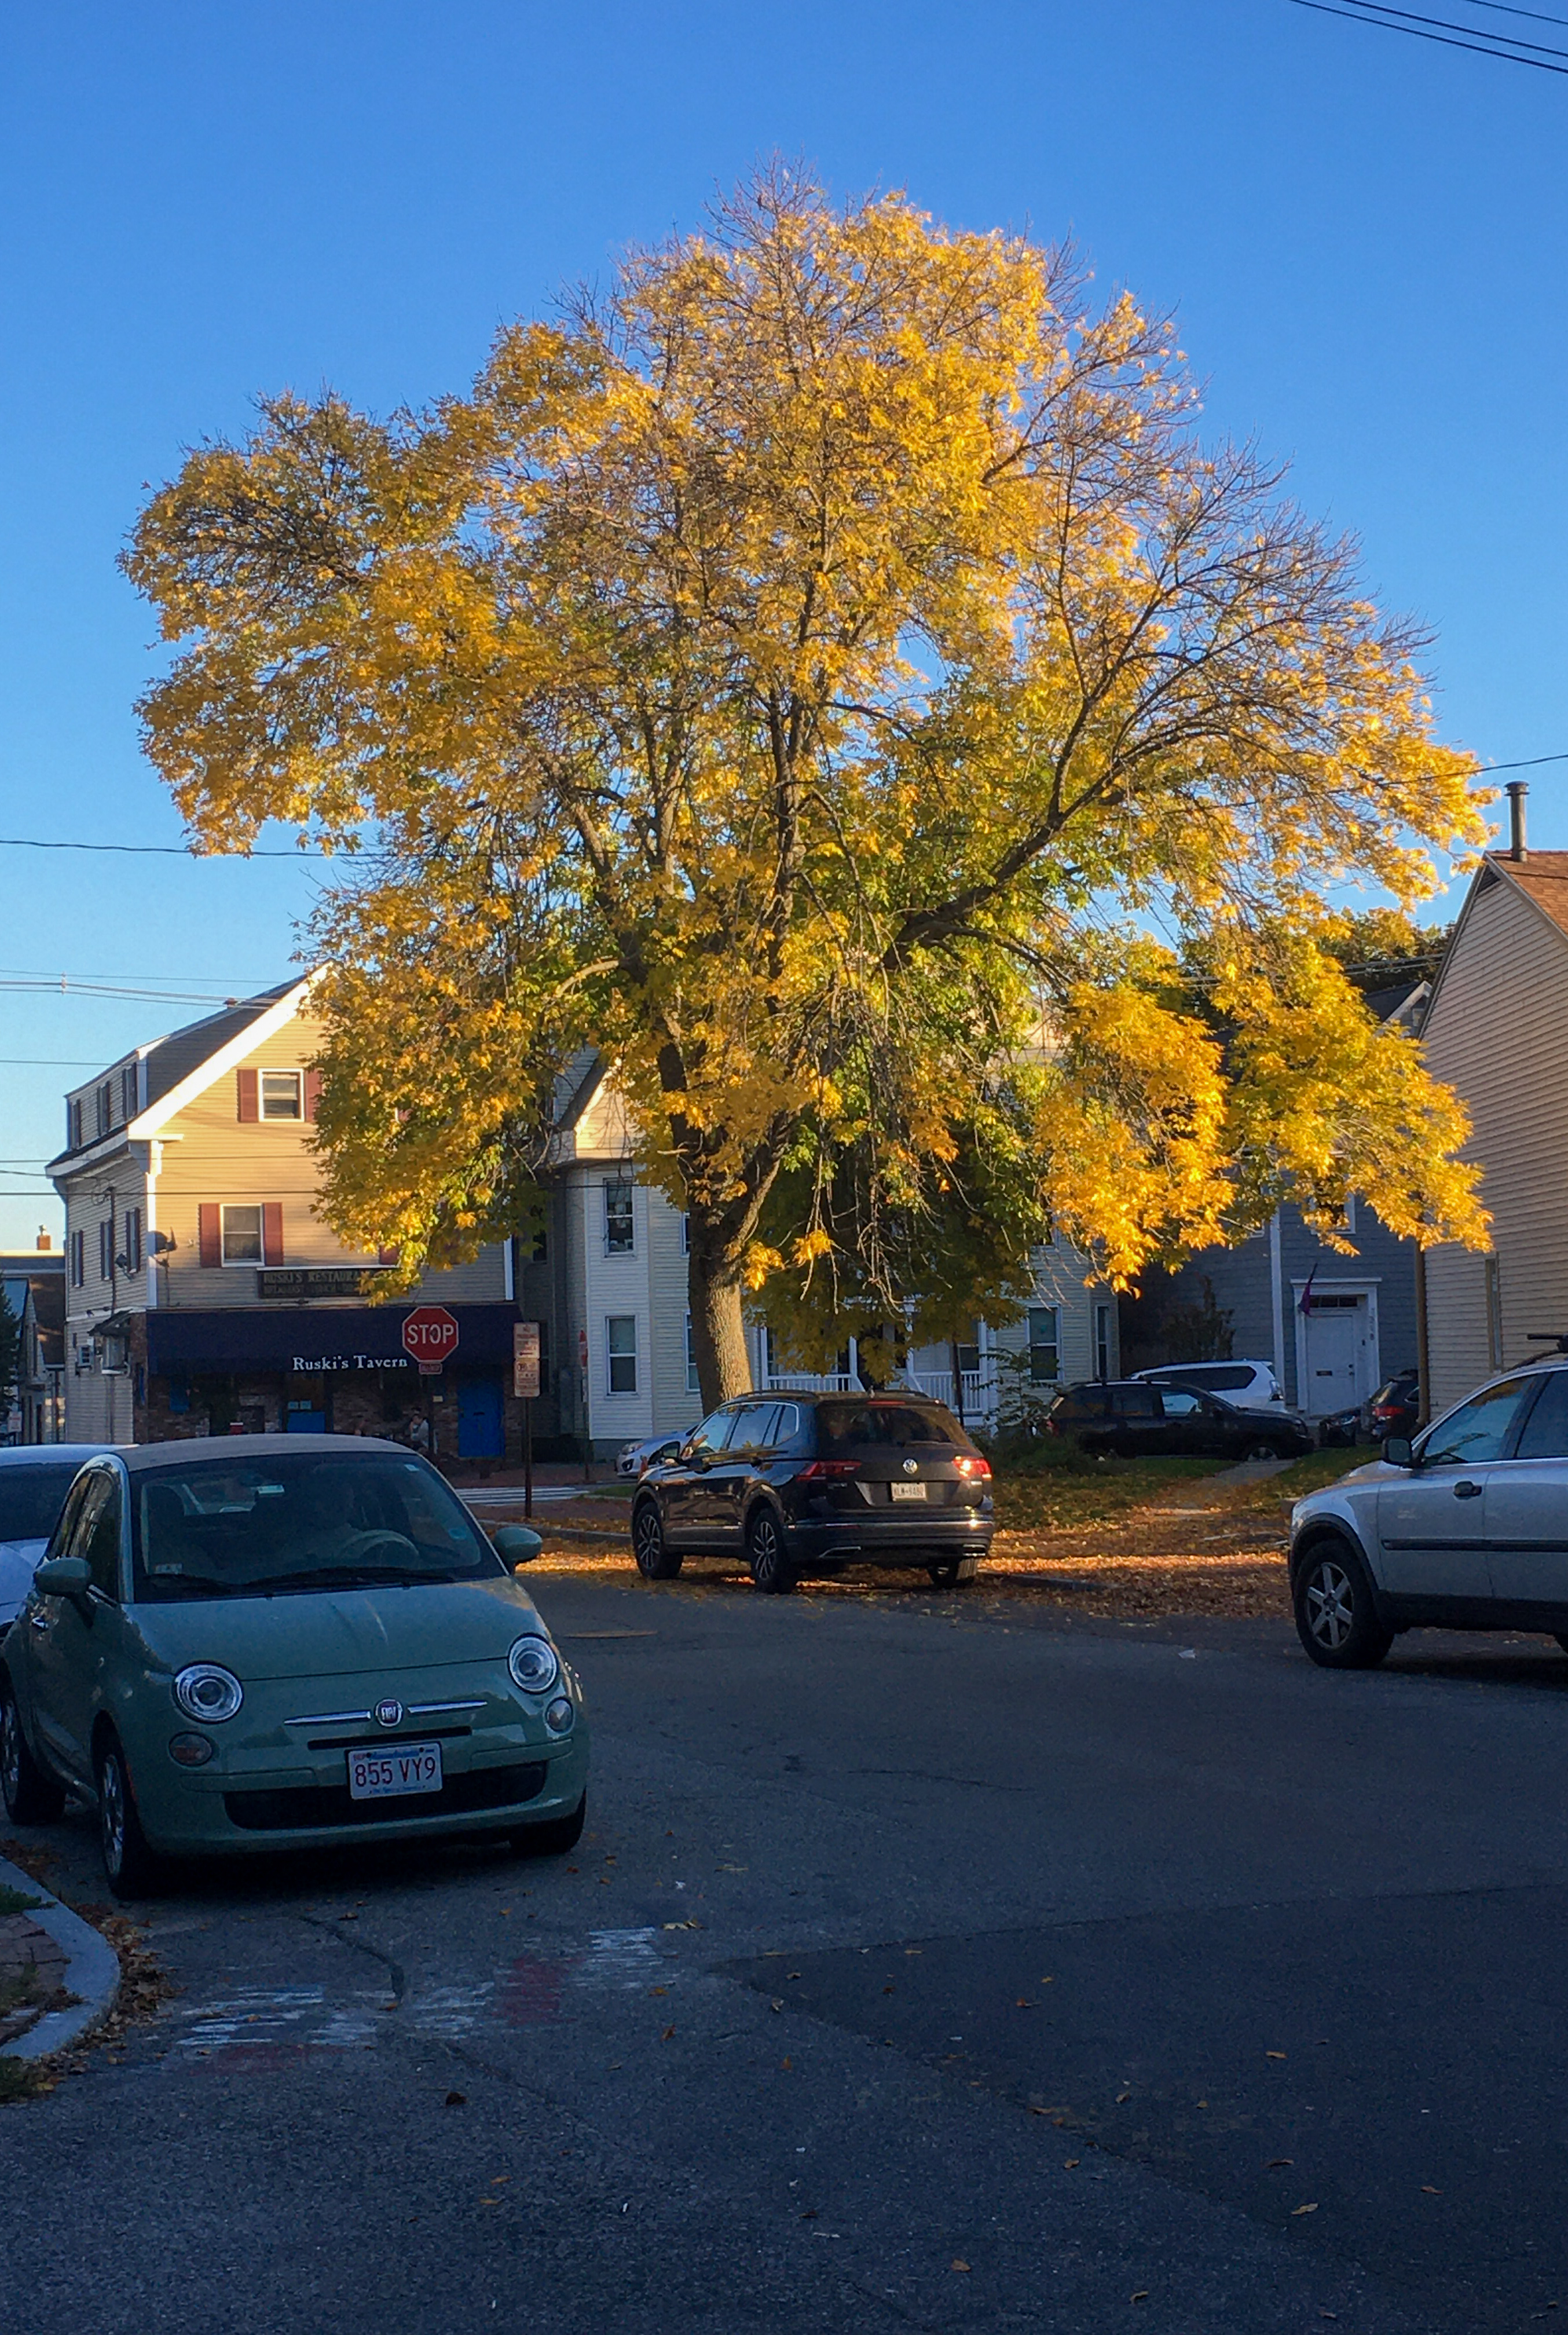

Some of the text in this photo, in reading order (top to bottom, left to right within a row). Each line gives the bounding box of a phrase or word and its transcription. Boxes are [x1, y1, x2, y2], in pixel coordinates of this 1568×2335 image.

[407, 1324, 455, 1345] STOP
[292, 1355, 349, 1371] Ruski's
[353, 1355, 408, 1369] Tavern
[355, 1756, 436, 1787] 855 VY9
